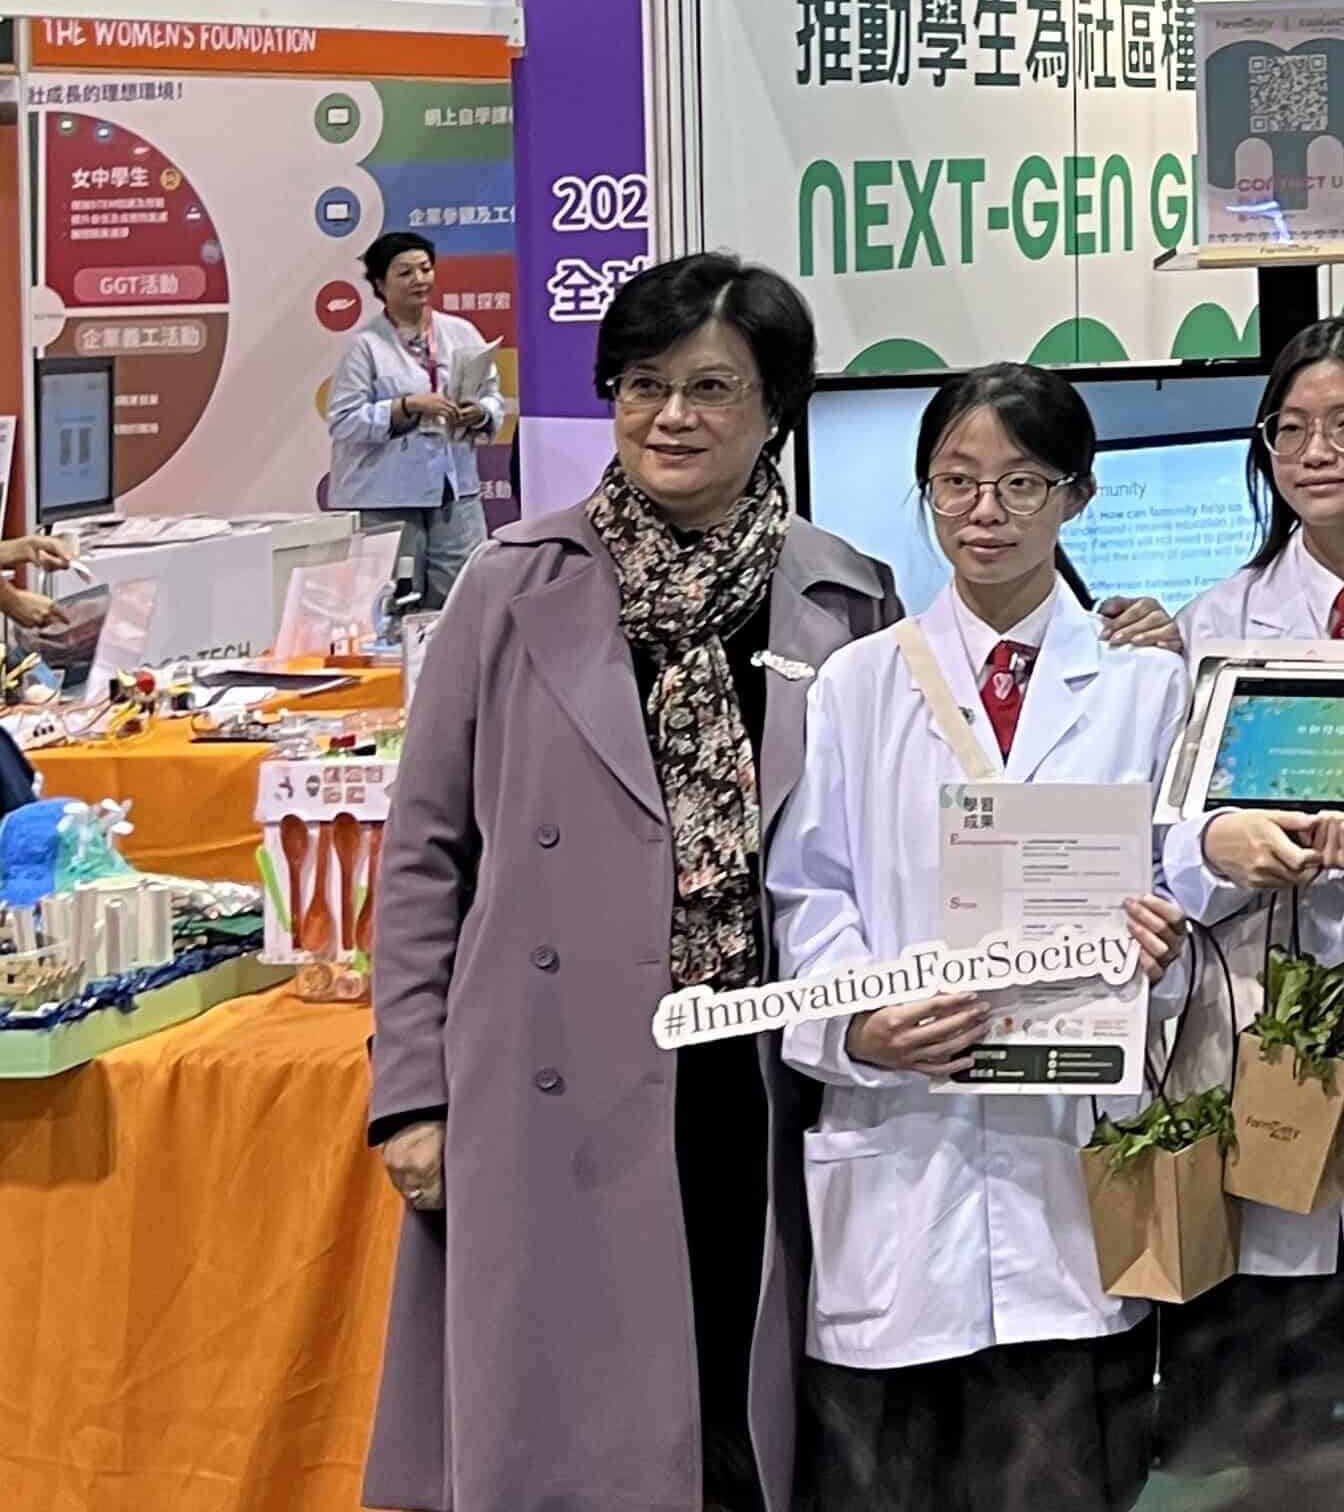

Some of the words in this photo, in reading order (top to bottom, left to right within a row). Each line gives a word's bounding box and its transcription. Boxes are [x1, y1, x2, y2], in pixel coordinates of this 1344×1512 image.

[42, 19, 87, 47] THE
[200, 25, 317, 53] FOUNDATION
[71, 167, 150, 189] 女中學生
[800, 153, 1133, 277] NEXT-GEN
[664, 934, 1136, 1039] #InnovationForSociety
